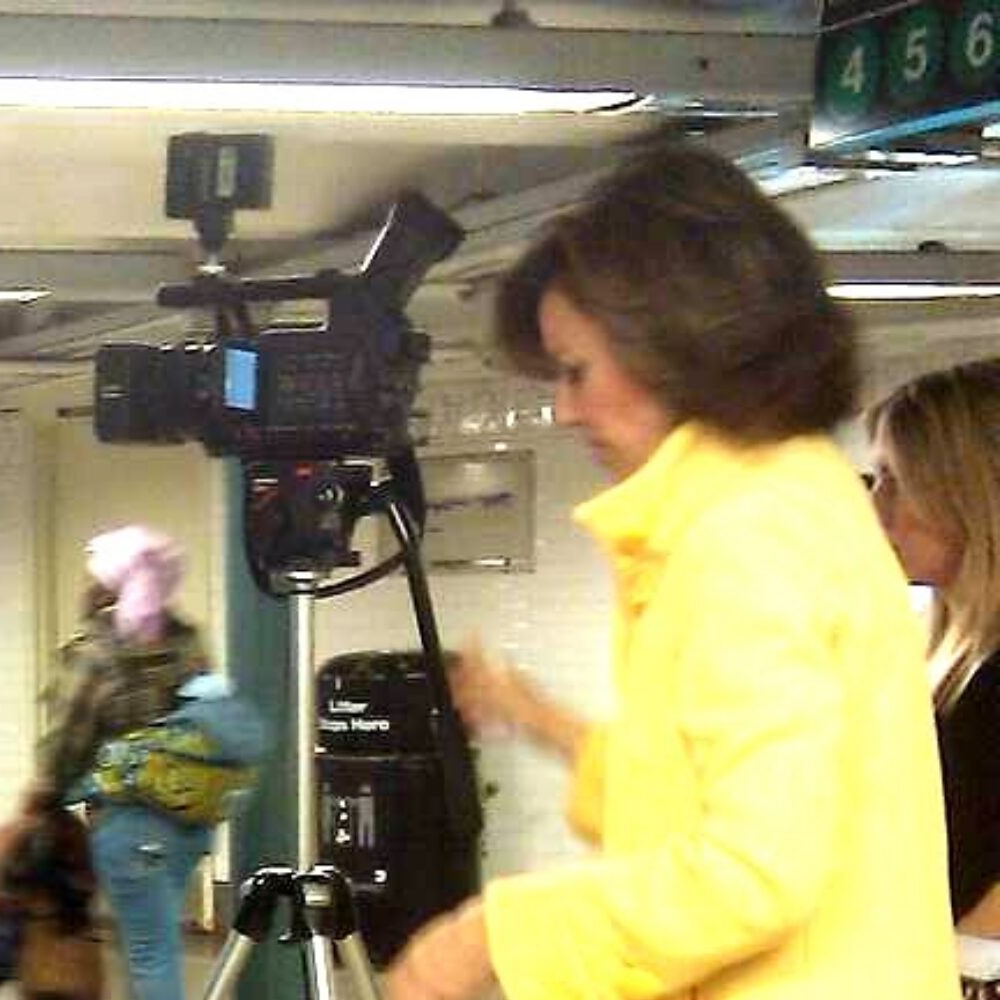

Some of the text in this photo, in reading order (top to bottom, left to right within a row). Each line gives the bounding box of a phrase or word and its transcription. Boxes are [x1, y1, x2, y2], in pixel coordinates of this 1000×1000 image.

[839, 12, 994, 93] 4 5 6
